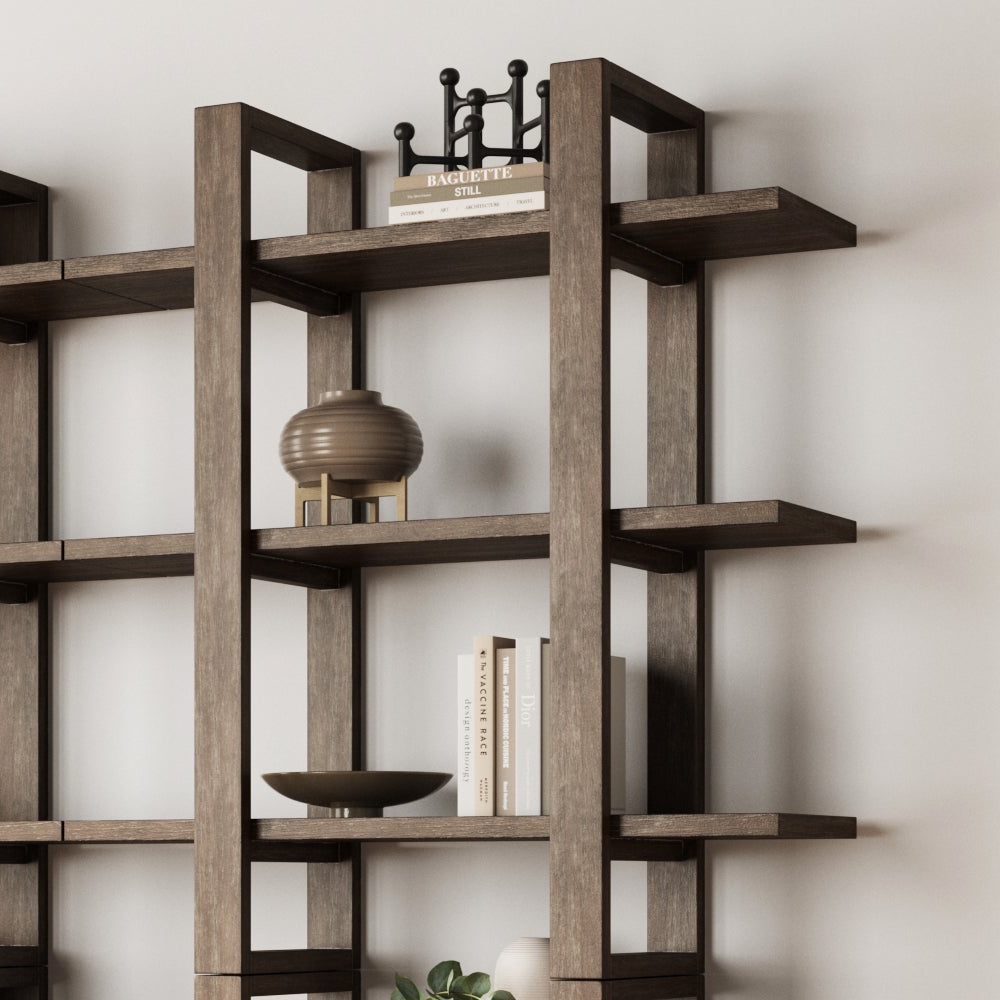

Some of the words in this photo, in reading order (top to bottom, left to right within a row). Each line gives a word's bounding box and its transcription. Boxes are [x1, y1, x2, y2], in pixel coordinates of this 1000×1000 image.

[427, 166, 512, 187] BAGUETTE
[454, 185, 481, 197] STILL
[462, 699, 472, 731] design
[520, 694, 536, 728] Dior
